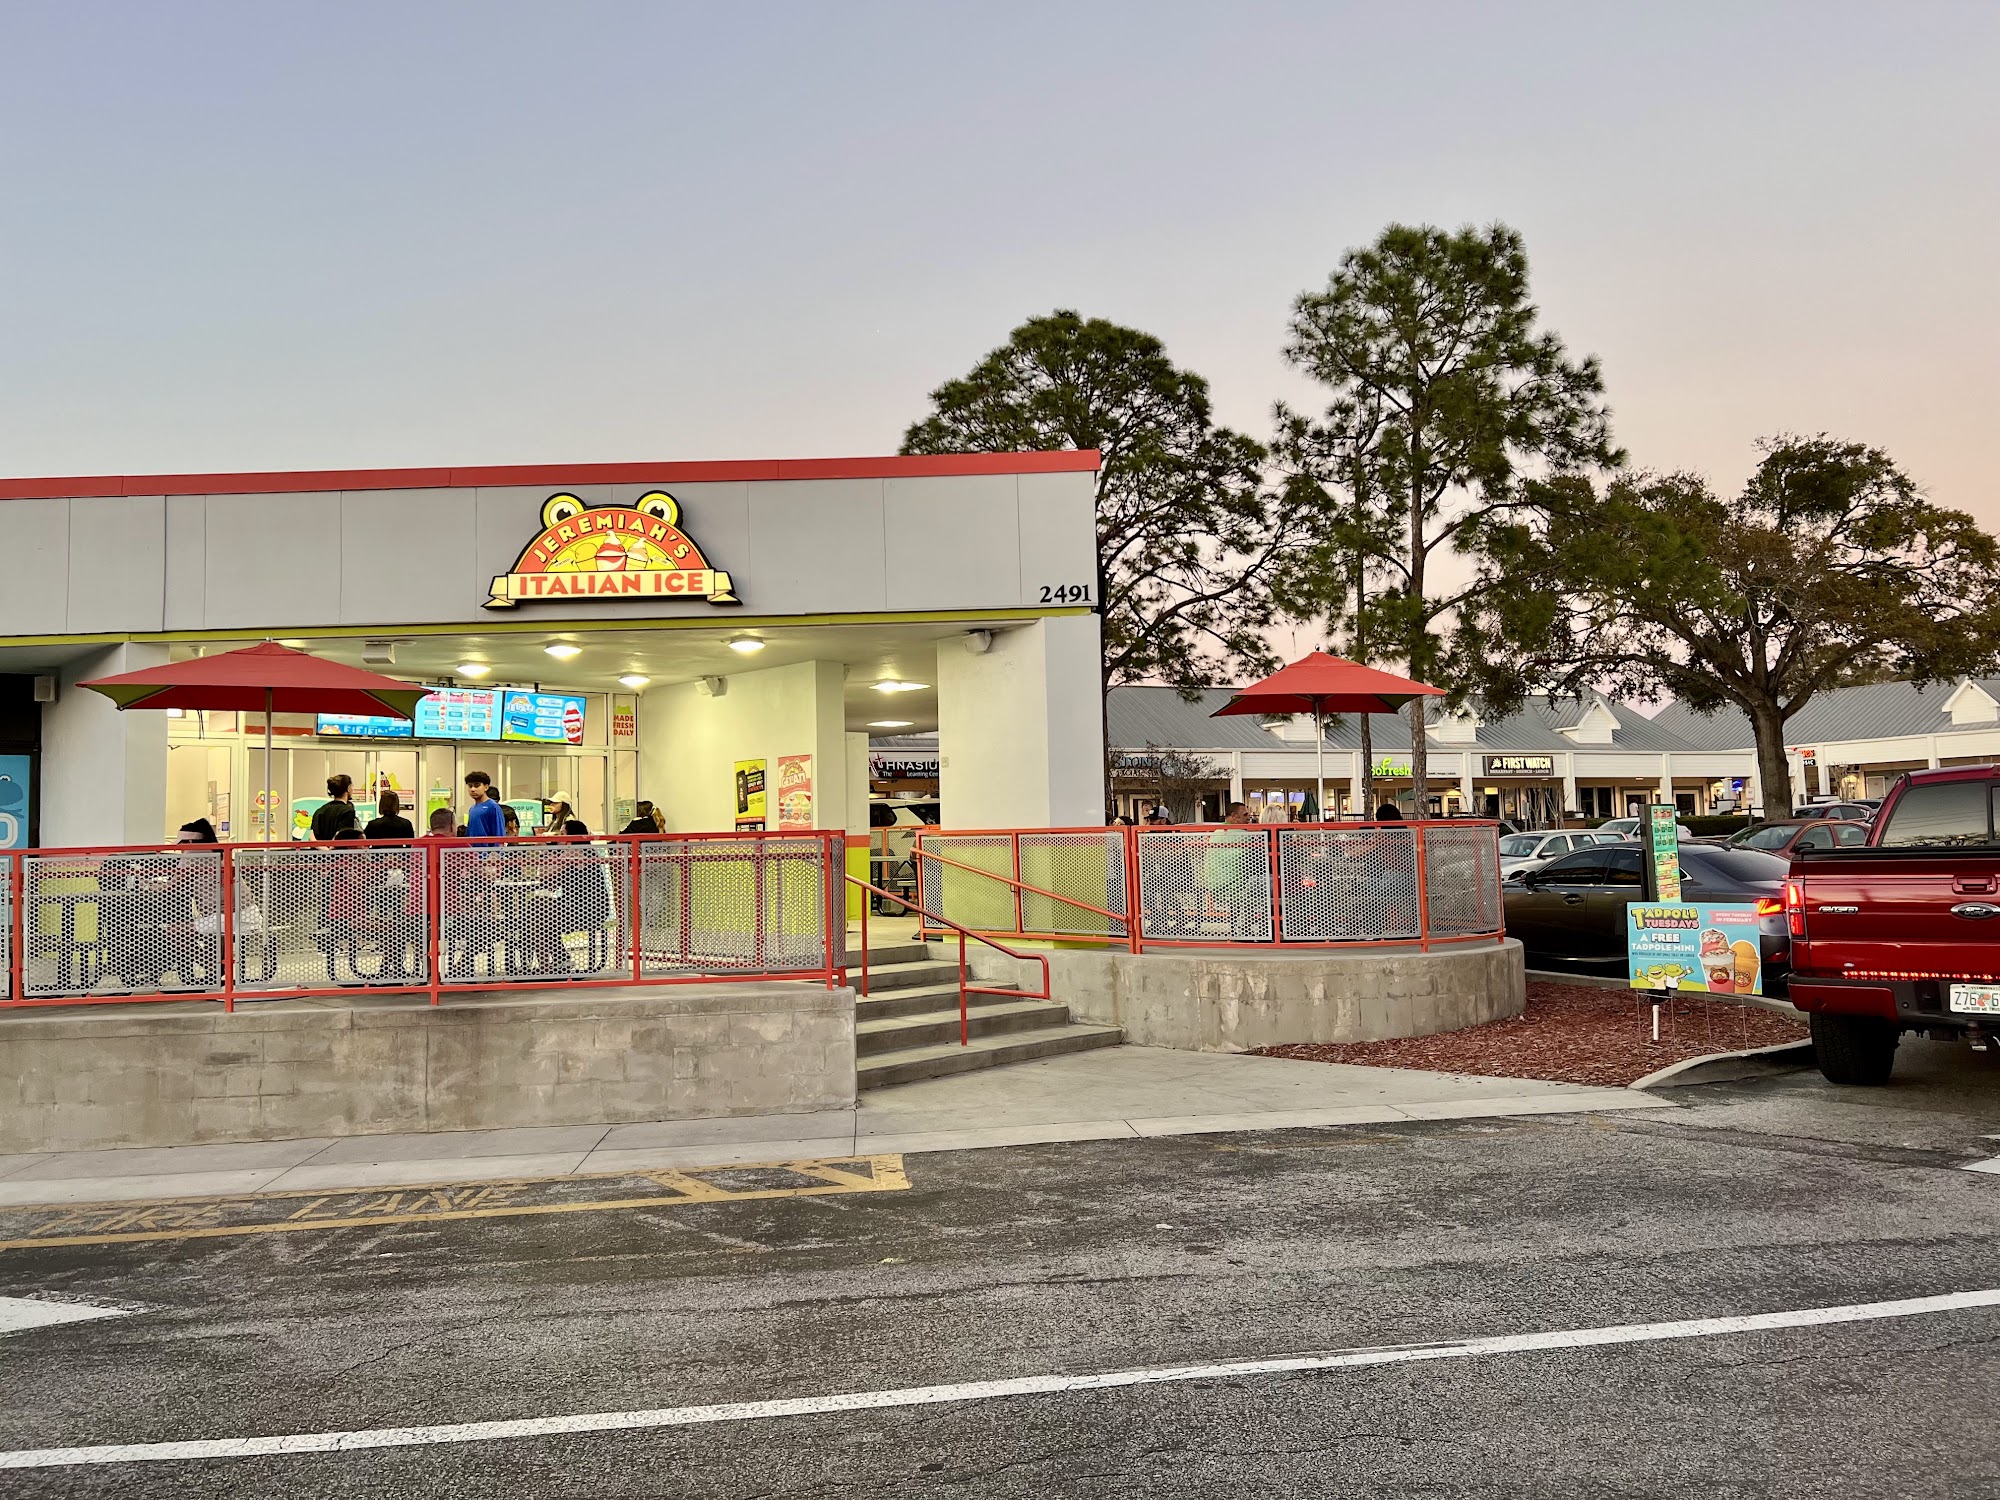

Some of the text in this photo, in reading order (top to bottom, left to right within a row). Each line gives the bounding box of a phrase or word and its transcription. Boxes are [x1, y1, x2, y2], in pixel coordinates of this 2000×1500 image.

[532, 513, 691, 563] JEREMIAH'S
[519, 572, 704, 596] ITALIAN ICE
[1040, 584, 1092, 603] 2491
[614, 714, 634, 722] MADE
[1502, 757, 1551, 769] FIRST WATCH
[906, 770, 929, 778] Learning
[1631, 908, 1698, 930] TADPOLE
[1645, 919, 1699, 929] TUESDAYS
[1640, 933, 1680, 943] A FREE
[1631, 943, 1695, 952] TADPOLE MINI
[287, 1186, 526, 1220] LANE
